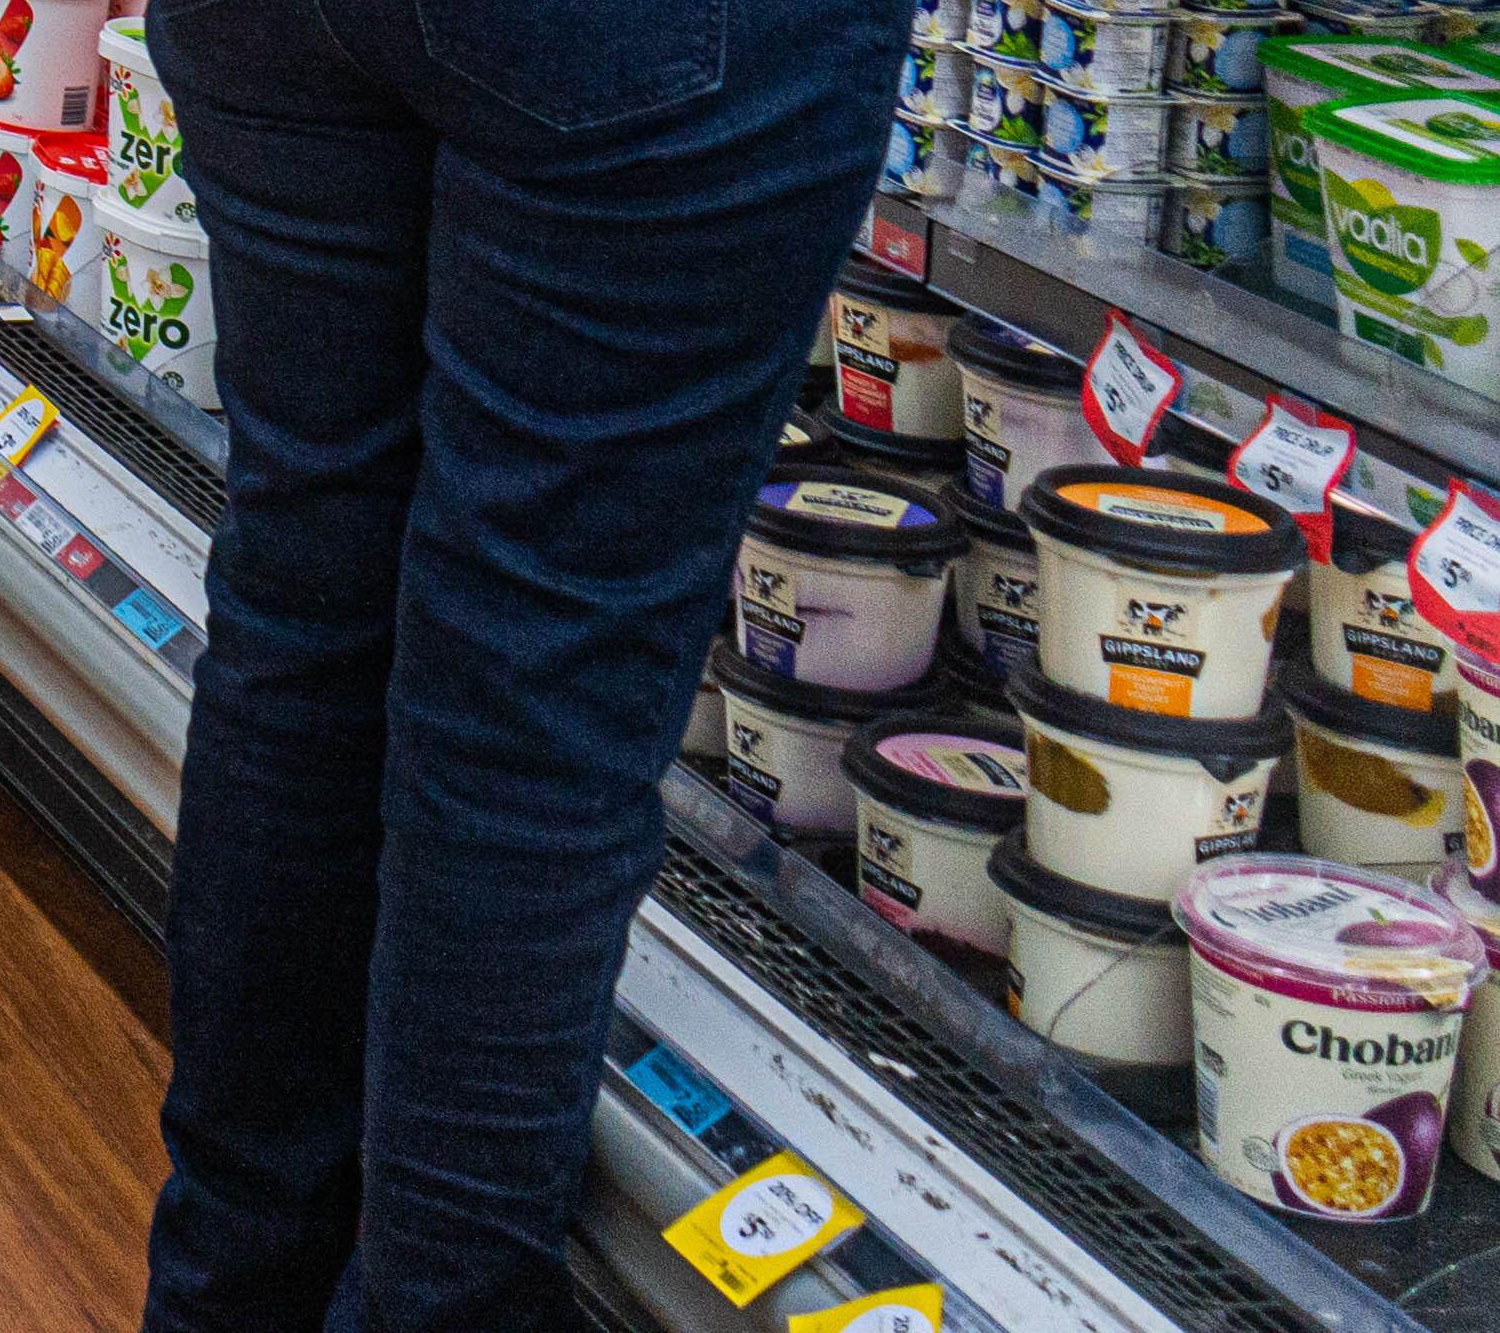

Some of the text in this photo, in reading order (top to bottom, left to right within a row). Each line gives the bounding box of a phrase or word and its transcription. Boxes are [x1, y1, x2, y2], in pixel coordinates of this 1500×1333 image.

[1328, 202, 1428, 266] vaalia
[110, 296, 191, 350] zero
[1104, 638, 1200, 670] GIPPSLAND
[1347, 629, 1439, 663] GIPPSLAND
